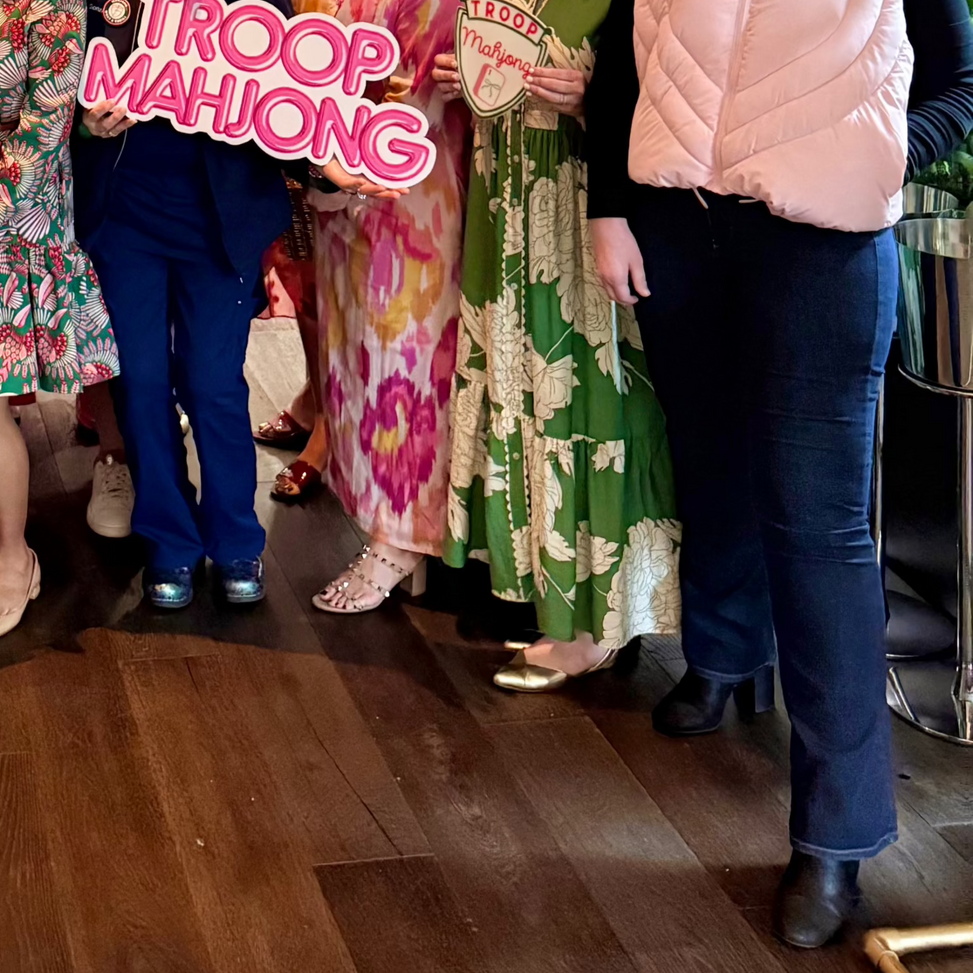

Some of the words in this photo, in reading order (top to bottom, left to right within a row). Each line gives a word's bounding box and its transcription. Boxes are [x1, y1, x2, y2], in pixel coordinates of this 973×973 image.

[471, 0, 538, 36] TROOP
[462, 26, 532, 80] Mahjong
[84, 42, 429, 182] MAHJONG
